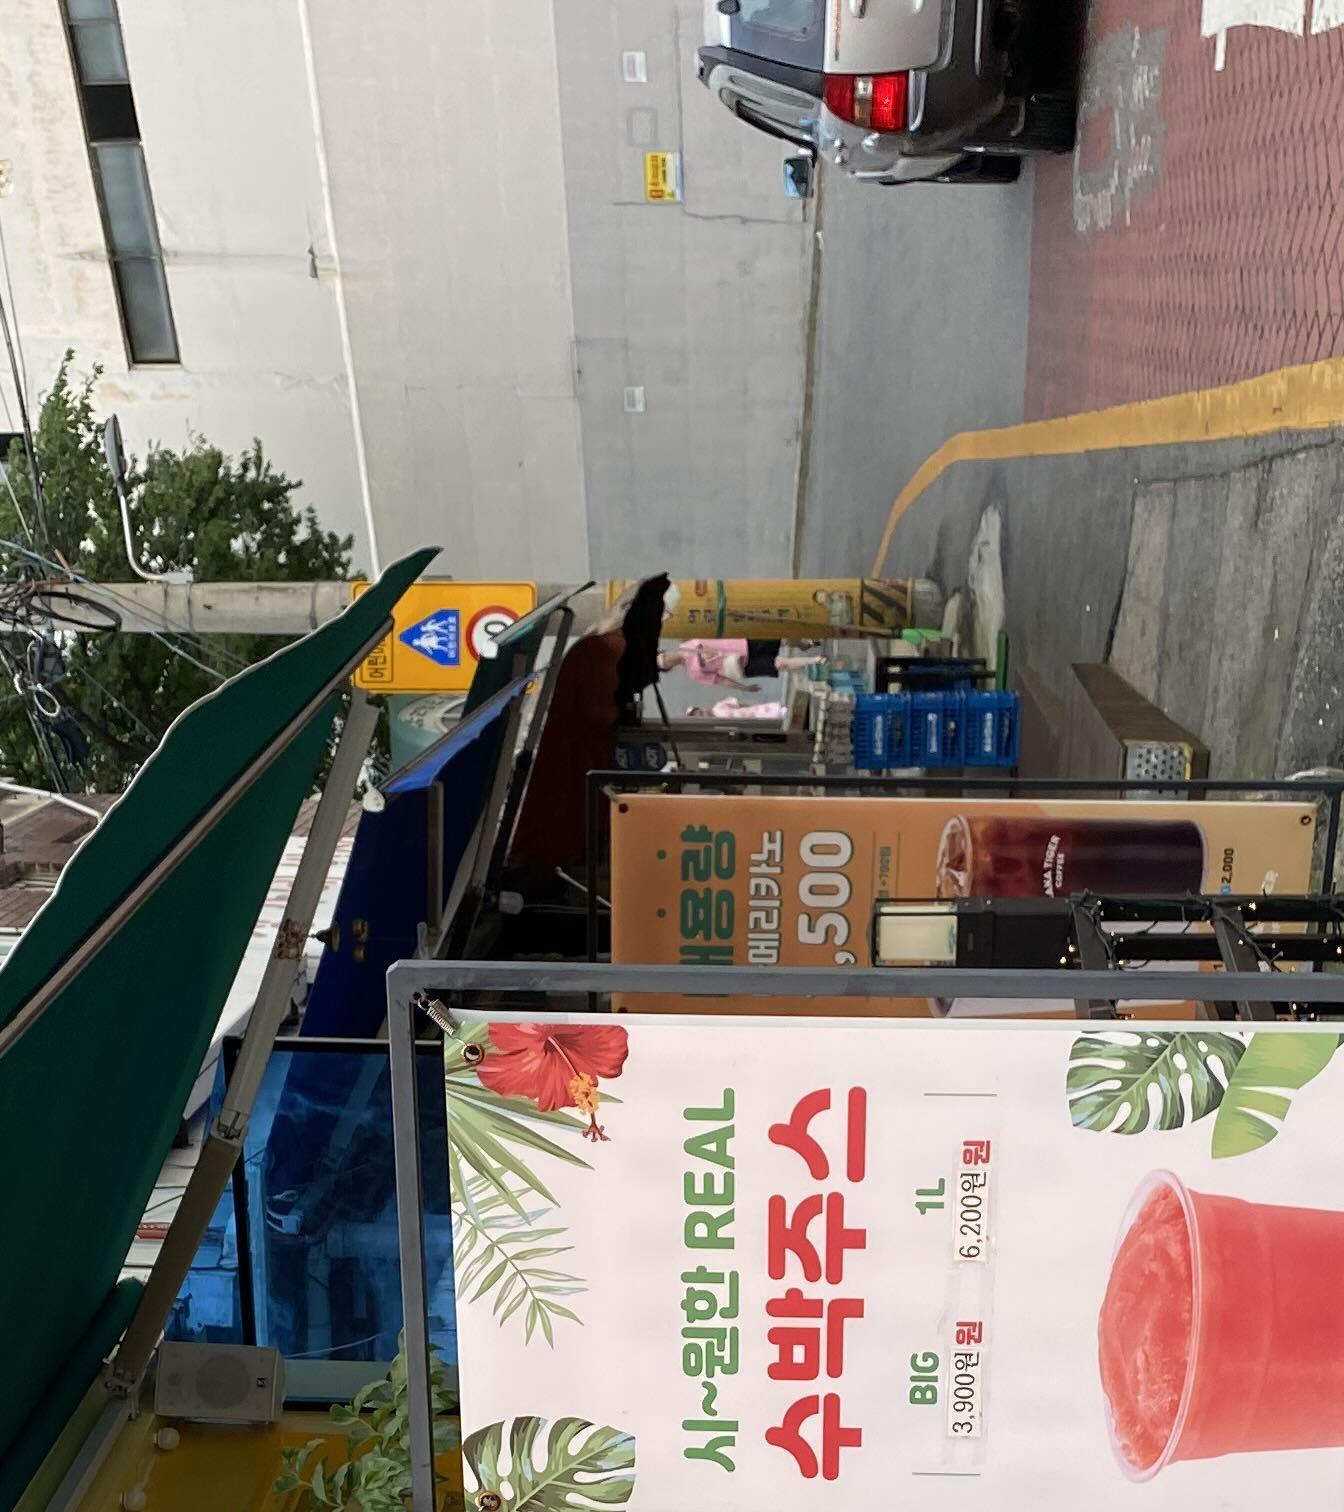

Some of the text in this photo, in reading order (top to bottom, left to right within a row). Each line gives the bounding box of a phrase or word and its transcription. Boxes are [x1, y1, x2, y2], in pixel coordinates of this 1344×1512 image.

[645, 745, 658, 769] ADT
[746, 829, 784, 968] 메리카노
[796, 830, 856, 966] ,500
[1042, 834, 1061, 898] ANA TIGER
[1055, 853, 1065, 888] COFFEE
[958, 1171, 988, 1259] 6,200원
[680, 1087, 740, 1474] 시~원한 REAL
[764, 1085, 868, 1481] 수박주스
[908, 1177, 946, 1406] BIG 1L
[951, 1351, 981, 1434] 3,900원
